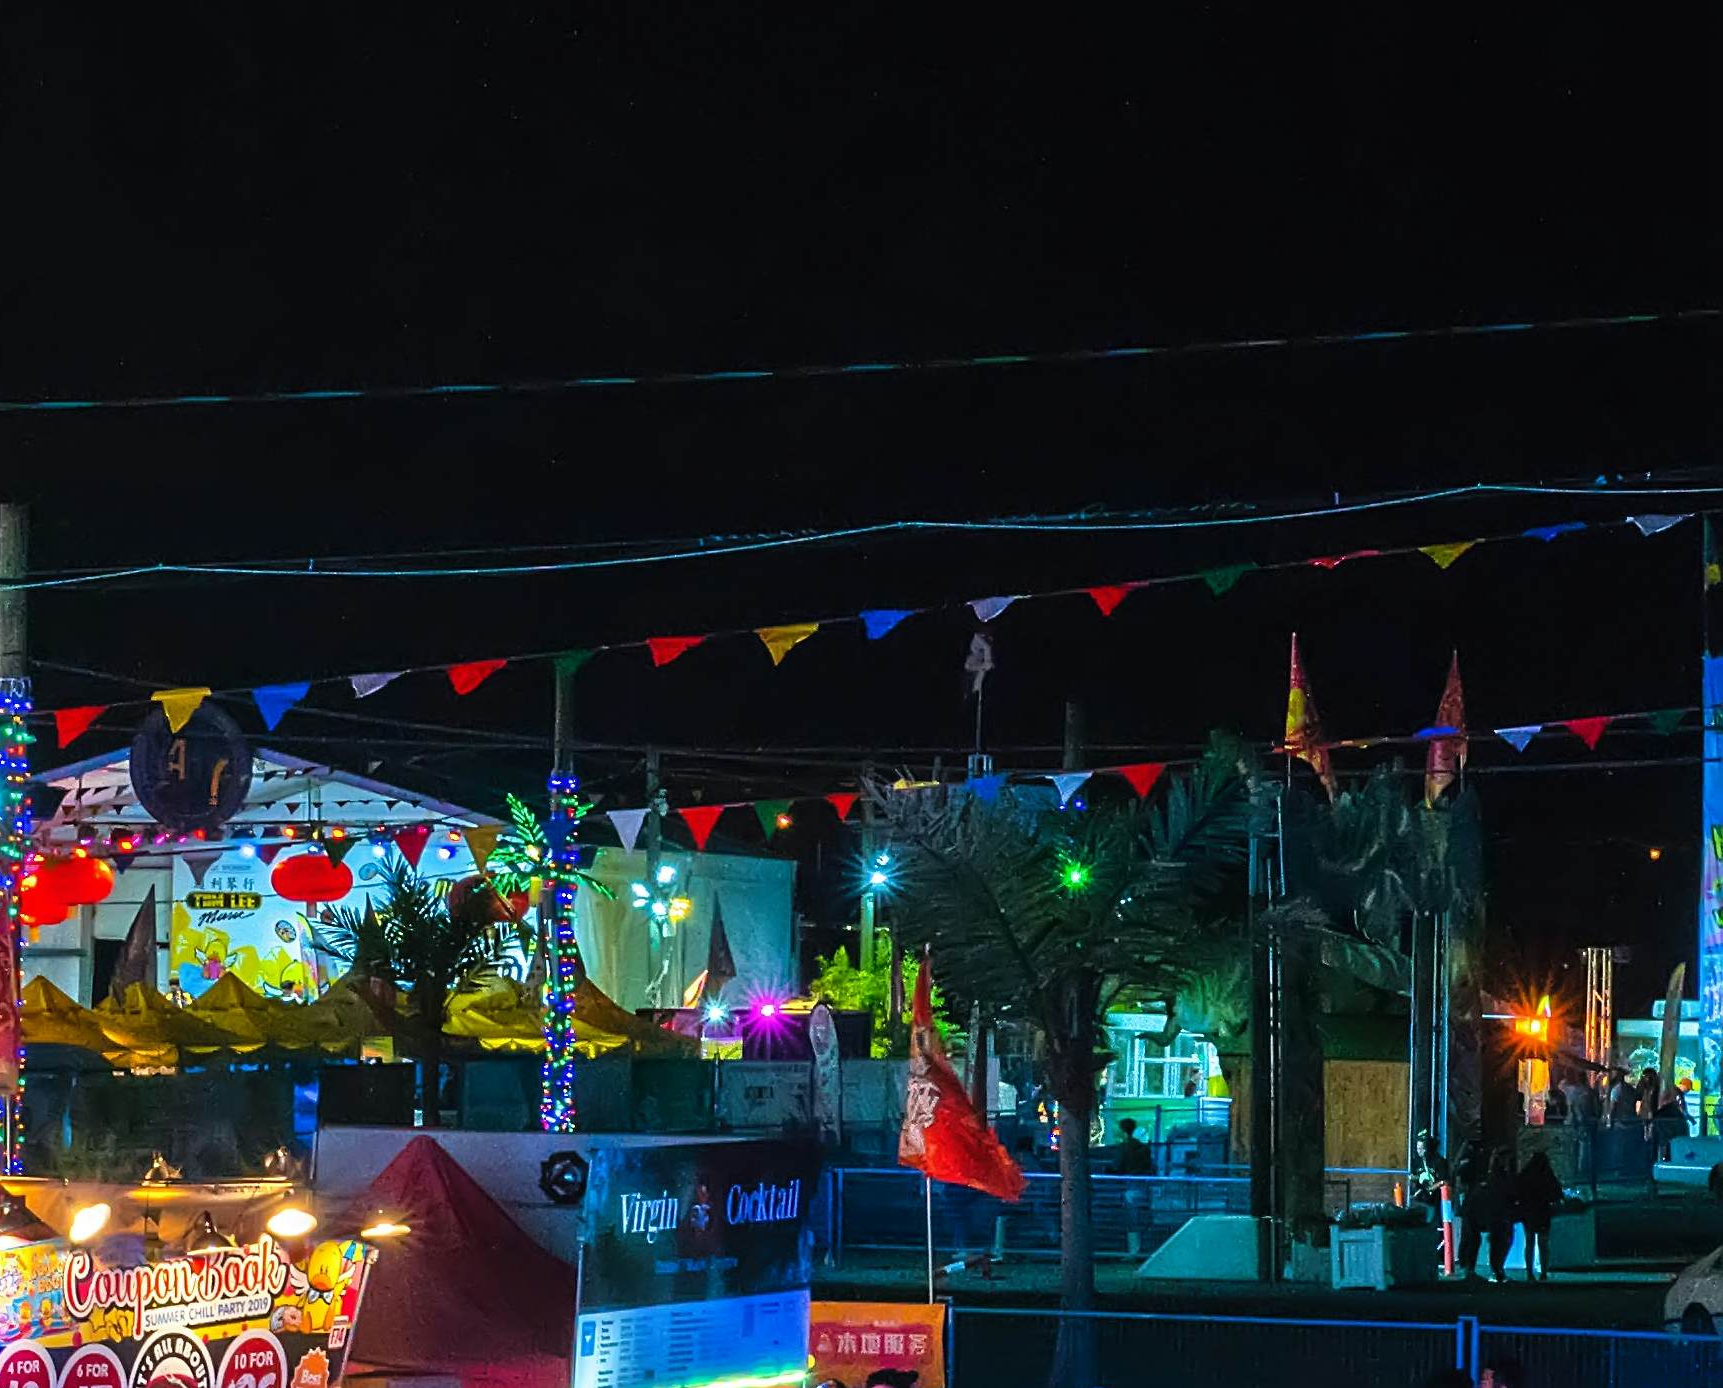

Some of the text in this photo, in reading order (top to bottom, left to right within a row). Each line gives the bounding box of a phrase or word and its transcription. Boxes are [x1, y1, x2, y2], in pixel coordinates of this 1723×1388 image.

[619, 1179, 802, 1243] Virgin Cocktail
[63, 1233, 288, 1341] Coupon Book
[145, 1296, 270, 1328] SUMMER CHILL PARTY 2019
[7, 1359, 41, 1375] 4 FOR
[76, 1363, 109, 1378] 6 FOR
[234, 1350, 274, 1370] 10 FOR
